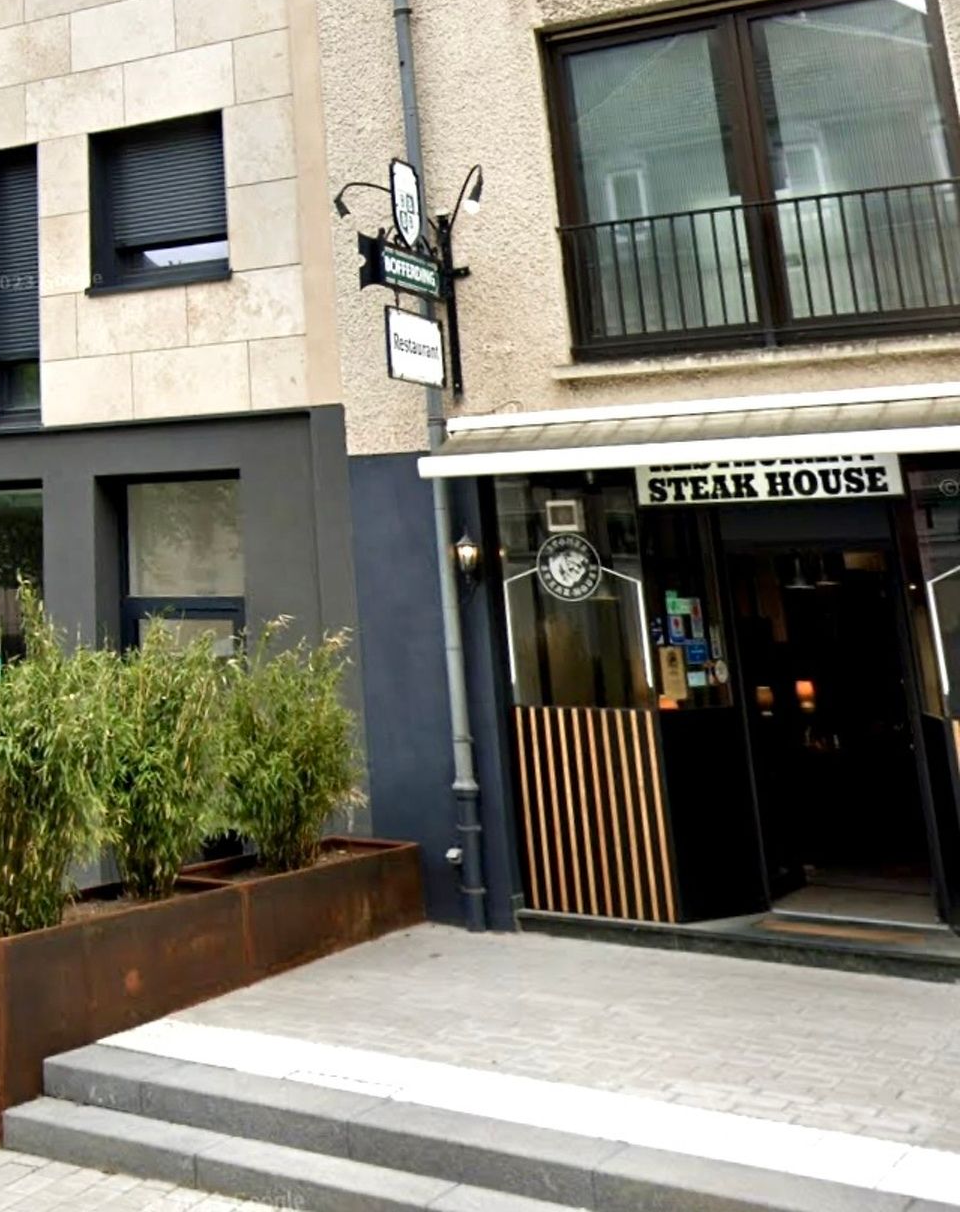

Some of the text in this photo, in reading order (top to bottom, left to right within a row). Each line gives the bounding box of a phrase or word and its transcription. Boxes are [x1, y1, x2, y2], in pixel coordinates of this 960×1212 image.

[384, 255, 436, 287] BOFFERDING
[393, 332, 440, 360] Restaurant
[647, 466, 889, 503] STEAK HOUSE
